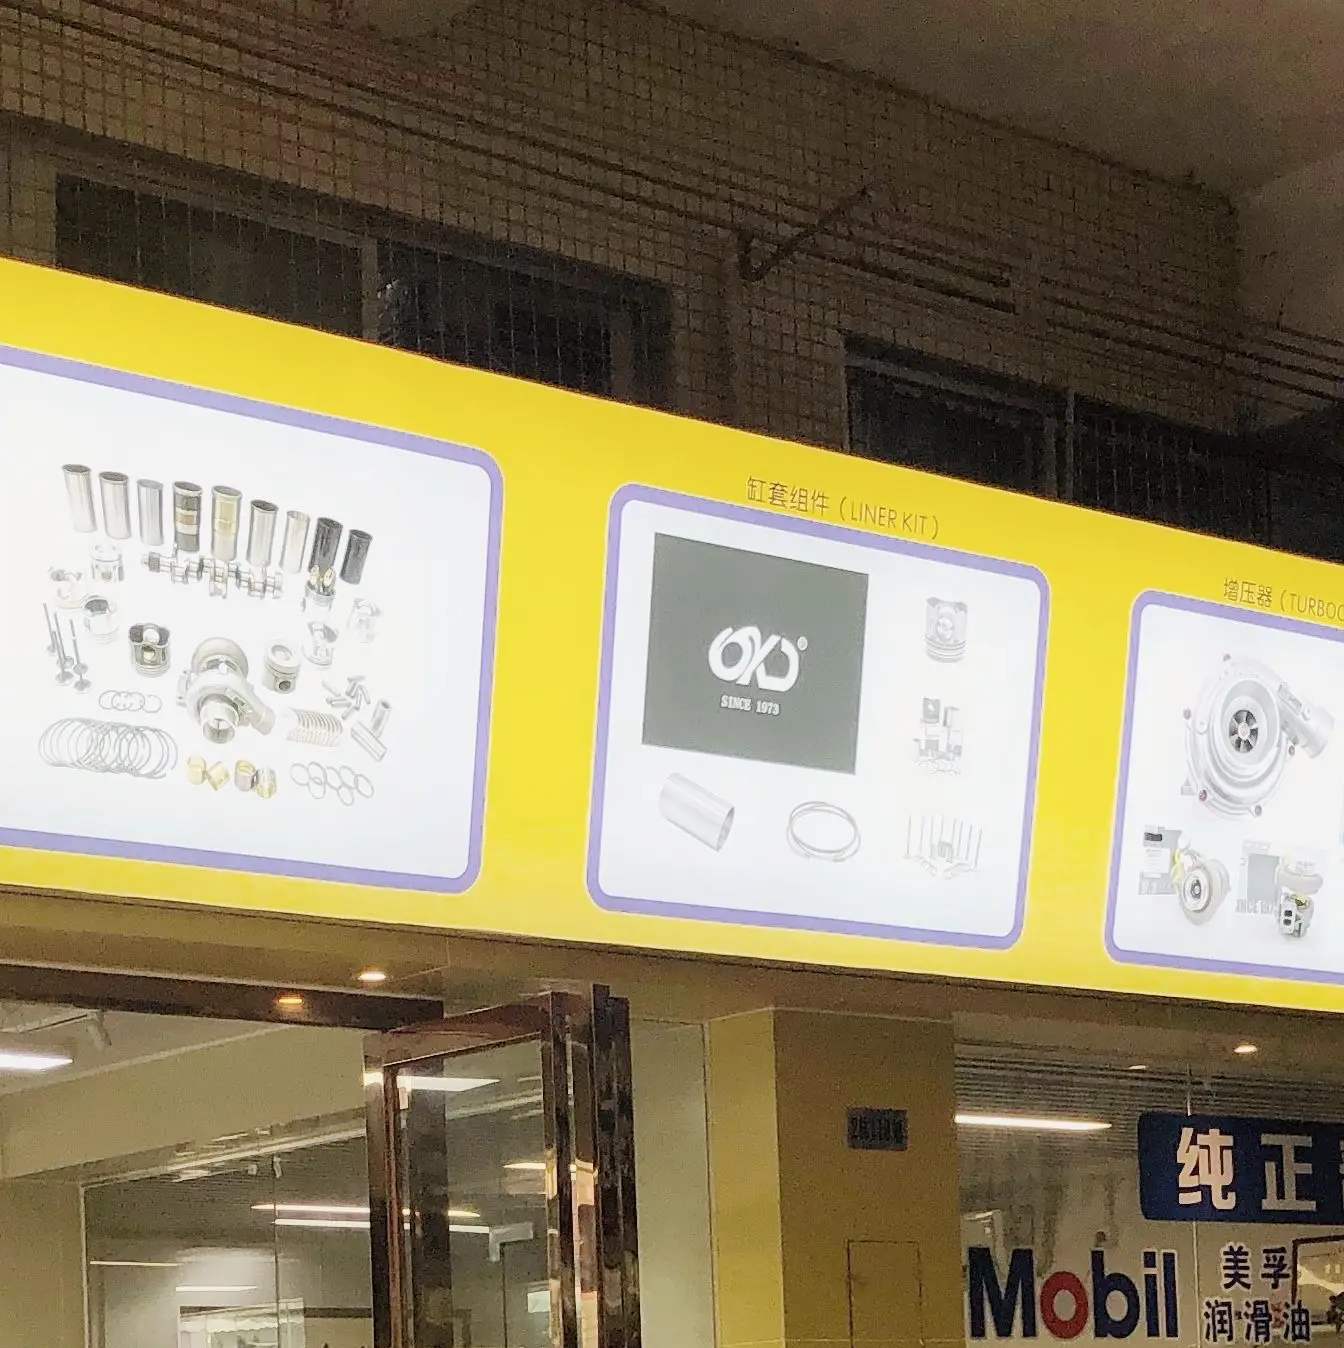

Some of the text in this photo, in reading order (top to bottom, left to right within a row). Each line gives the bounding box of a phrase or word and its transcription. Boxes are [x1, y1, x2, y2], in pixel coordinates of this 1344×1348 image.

[747, 475, 830, 517] 缸套组件
[1224, 577, 1273, 608] 增压器
[720, 694, 781, 716] SINCE 1973
[1221, 1243, 1292, 1291] 美孚
[967, 1247, 1179, 1340] Mobil
[1203, 1299, 1312, 1344] 润滑油
